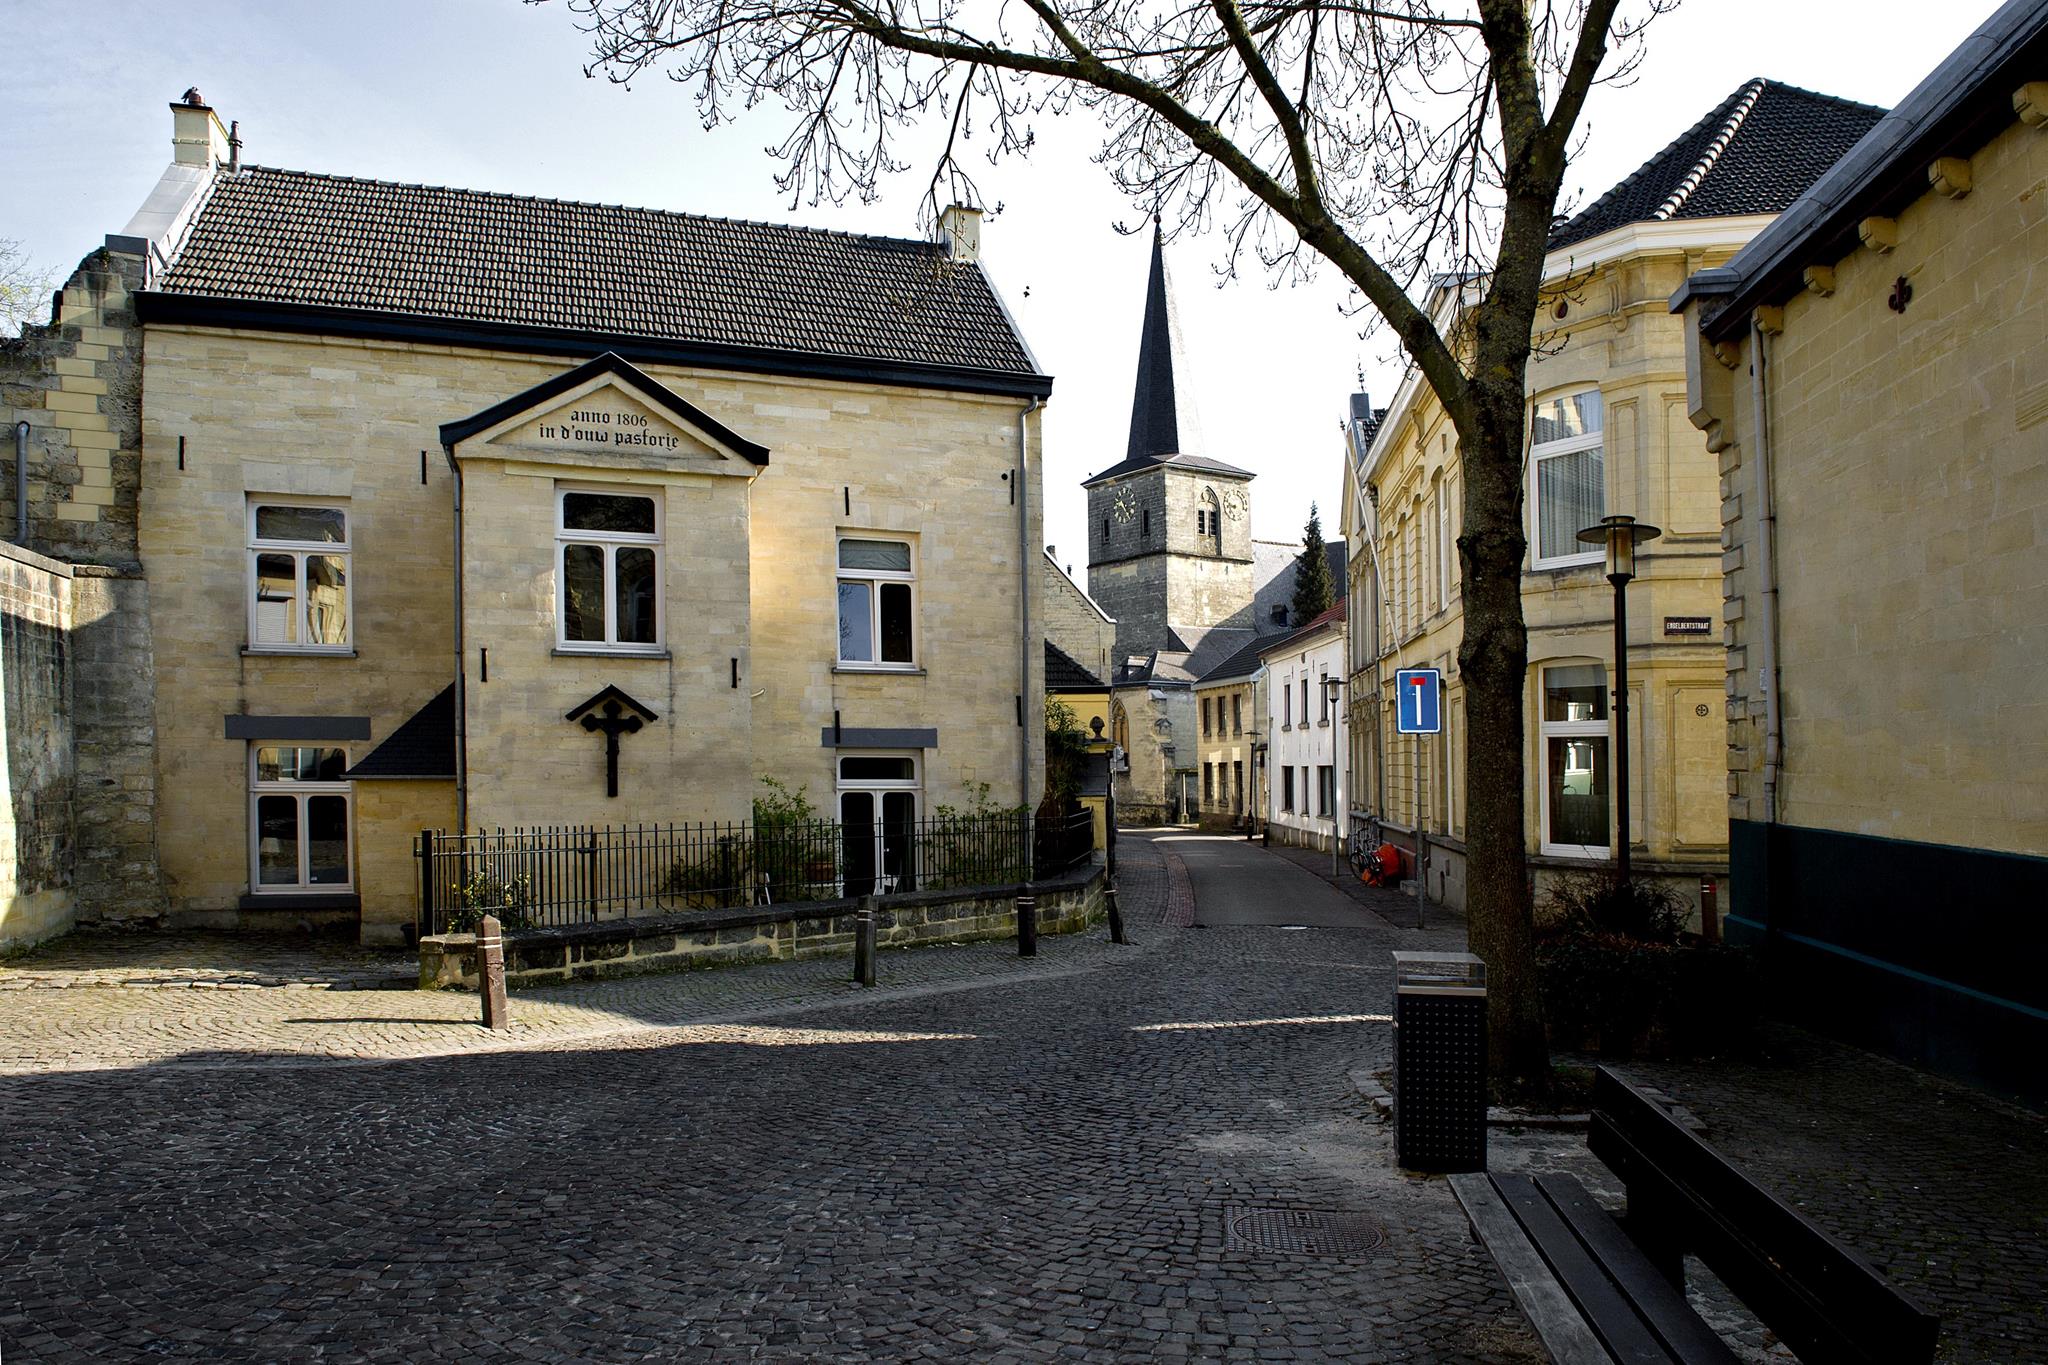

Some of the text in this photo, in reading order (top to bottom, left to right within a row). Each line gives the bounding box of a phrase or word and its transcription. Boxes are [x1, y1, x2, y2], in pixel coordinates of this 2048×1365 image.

[571, 410, 648, 427] anno 1806
[540, 423, 555, 438] in
[561, 425, 608, 442] d'ouw
